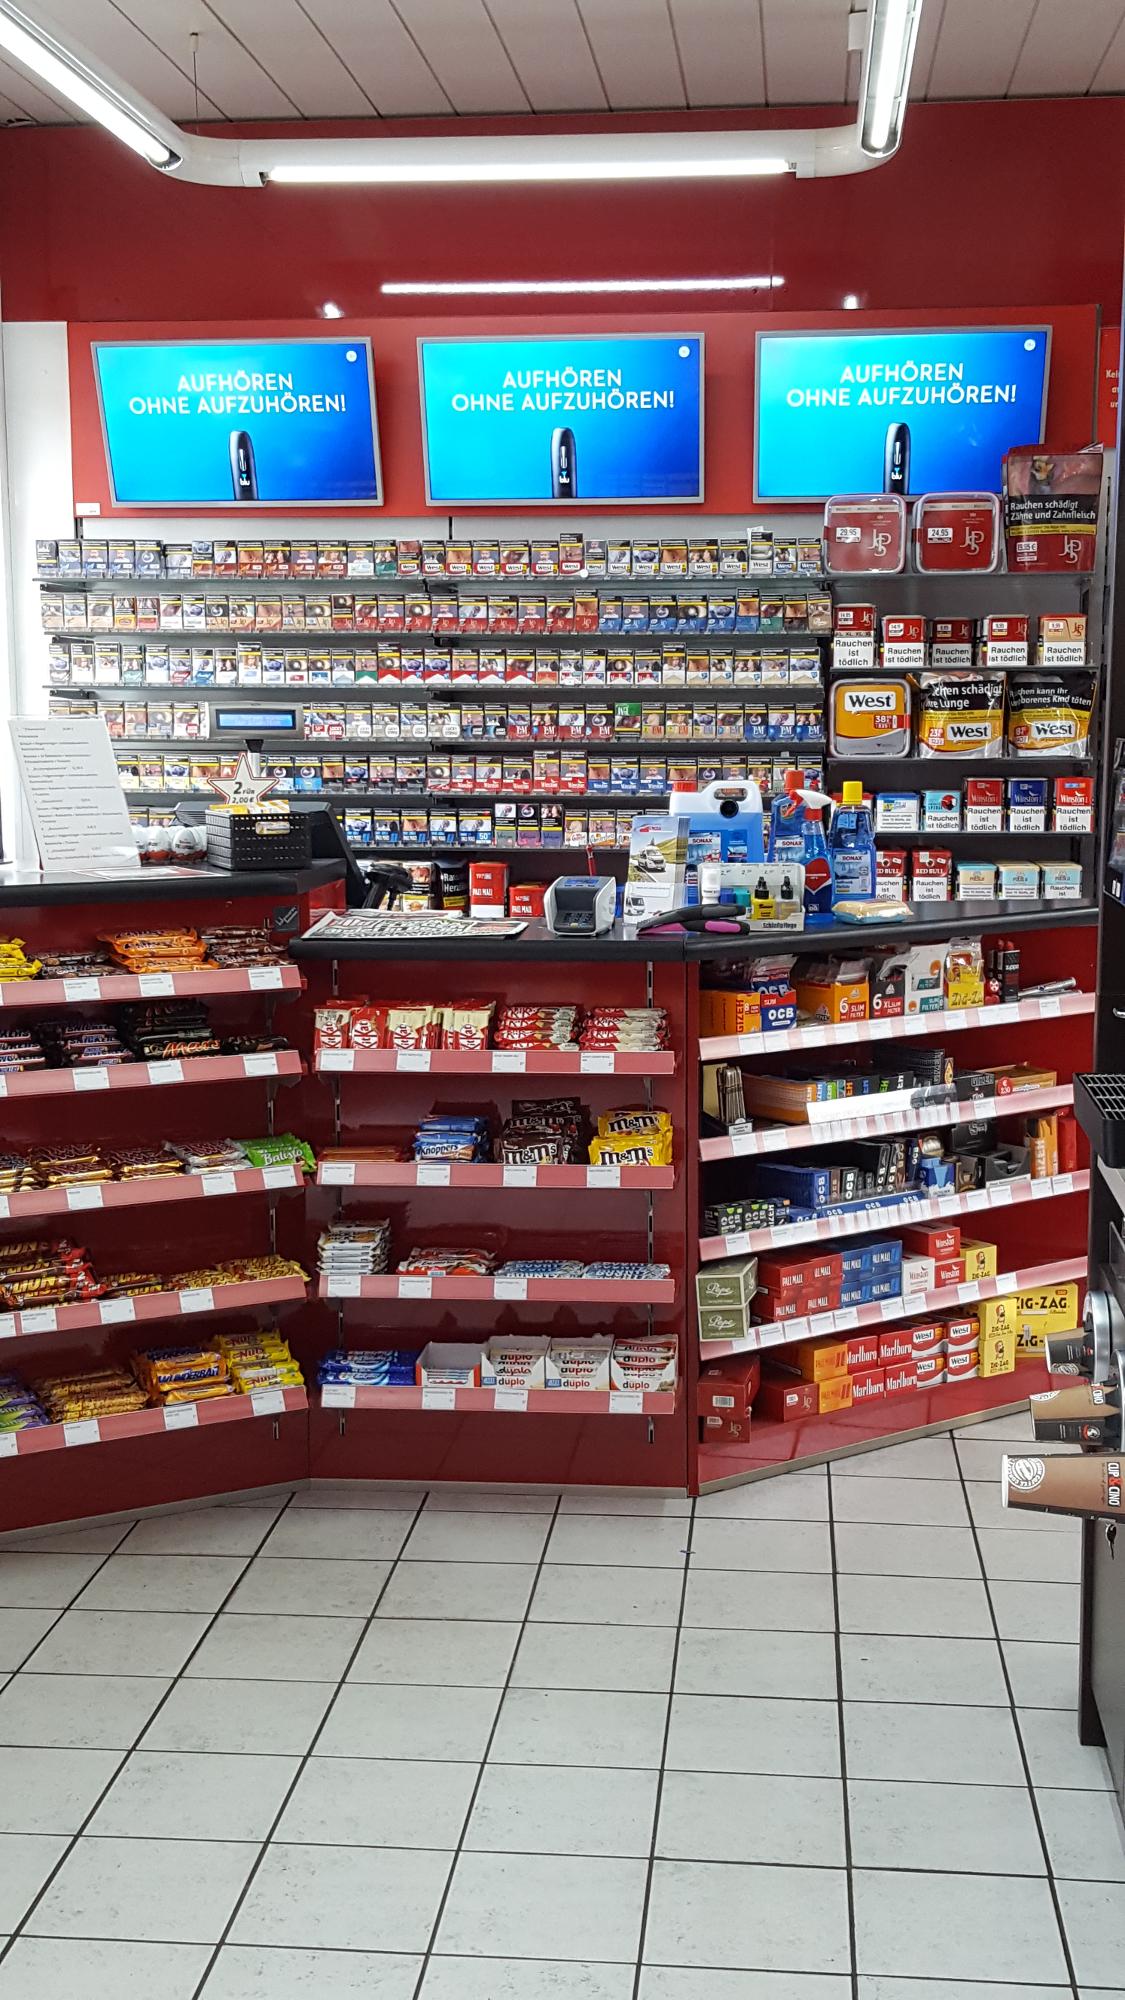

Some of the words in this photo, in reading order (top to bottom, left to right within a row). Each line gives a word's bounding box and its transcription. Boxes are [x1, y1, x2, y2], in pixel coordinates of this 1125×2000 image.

[840, 361, 963, 383] AUFHÖREN
[178, 370, 293, 392] AUFHÖREN
[503, 367, 622, 388] AUFHÖREN
[787, 387, 850, 407] OHNE
[857, 382, 1016, 406] AUFZUHÖREN!
[129, 397, 190, 414] OHNE
[197, 392, 346, 414] AUFZUHÖREN!
[452, 393, 514, 411] OHNE
[521, 389, 675, 410] AUFZUHÖREN!
[1010, 500, 1043, 510] Rauchen
[1044, 500, 1078, 511] schädigt
[1010, 512, 1033, 521] Zähne
[1034, 511, 1051, 520] und
[1052, 511, 1096, 521] Zahnfleisch
[835, 639, 873, 648] Rauchen
[848, 649, 859, 657] ist
[887, 647, 922, 655] Rauchen
[936, 648, 970, 656] Rauchen
[991, 646, 1026, 654] Rauchen
[1047, 647, 1082, 655] Rauchen
[838, 656, 869, 666] tödlich
[885, 655, 895, 663] ist
[896, 655, 923, 663] tödlich
[933, 656, 944, 664] ist
[944, 656, 971, 664] tödlich
[988, 654, 999, 662] ist
[1000, 654, 1027, 662] tödlich
[1056, 654, 1083, 662] tödlich
[962, 683, 1003, 698] schädigt
[1036, 687, 1056, 696] kann
[1056, 687, 1068, 695] Ihr
[849, 694, 893, 709] West
[940, 698, 970, 710] Lunge
[1052, 695, 1070, 703] Kind
[1071, 697, 1092, 706] töten
[952, 724, 989, 738] West
[1034, 722, 1074, 736] West
[233, 782, 243, 794] 2
[1060, 795, 1086, 804] Winston
[978, 816, 989, 824] ist
[1022, 816, 1032, 824] ist
[1068, 816, 1079, 824] ist
[936, 822, 960, 830] tödlich
[970, 823, 998, 832] tödlich
[1013, 823, 1040, 832] tödlich
[1060, 823, 1087, 832] tödlich
[764, 998, 776, 1006] SLIM
[840, 998, 848, 1014] 6
[850, 1004, 865, 1012] SLIM
[873, 994, 882, 1010] 6
[922, 1002, 938, 1011] FILTER
[768, 1008, 794, 1020] OCB
[420, 1143, 459, 1157] Knoppers
[504, 1144, 558, 1165] m&m's
[262, 1149, 302, 1166] Balisto
[600, 1145, 654, 1166] m&m's
[818, 1176, 826, 1204] OCB
[846, 1172, 856, 1200] OCB
[720, 1216, 741, 1226] OCB
[744, 1211, 766, 1222] OCB
[935, 1237, 955, 1249] Winston
[822, 1266, 832, 1276] MALL
[909, 1270, 929, 1280] Winston
[940, 1270, 960, 1280] Winston
[972, 1271, 990, 1280] ZIG-ZAG
[782, 1277, 792, 1287] PALL
[792, 1274, 804, 1286] MALL
[705, 1283, 735, 1298] Pepe
[881, 1282, 890, 1292] MALL
[851, 1290, 861, 1300] MALL
[807, 1298, 818, 1309] PALL
[818, 1296, 828, 1307] MALL
[1016, 1296, 1067, 1311] ZIG-ZAG
[776, 1306, 786, 1316] PALL
[786, 1304, 796, 1315] MALL
[708, 1315, 737, 1330] Pepe
[952, 1326, 969, 1336] West
[992, 1324, 1010, 1334] ZIG-ZAG
[915, 1332, 933, 1342] West
[880, 1340, 912, 1357] Marlboro
[623, 1354, 656, 1364] duplo
[951, 1356, 968, 1366] West
[917, 1362, 934, 1372] West
[990, 1360, 1009, 1370] ZIG-ZAG
[498, 1377, 526, 1388] duplo
[562, 1378, 591, 1390] duplo
[622, 1380, 650, 1391] duplo
[886, 1372, 918, 1390] Marlboro
[852, 1378, 884, 1398] Marlboro
